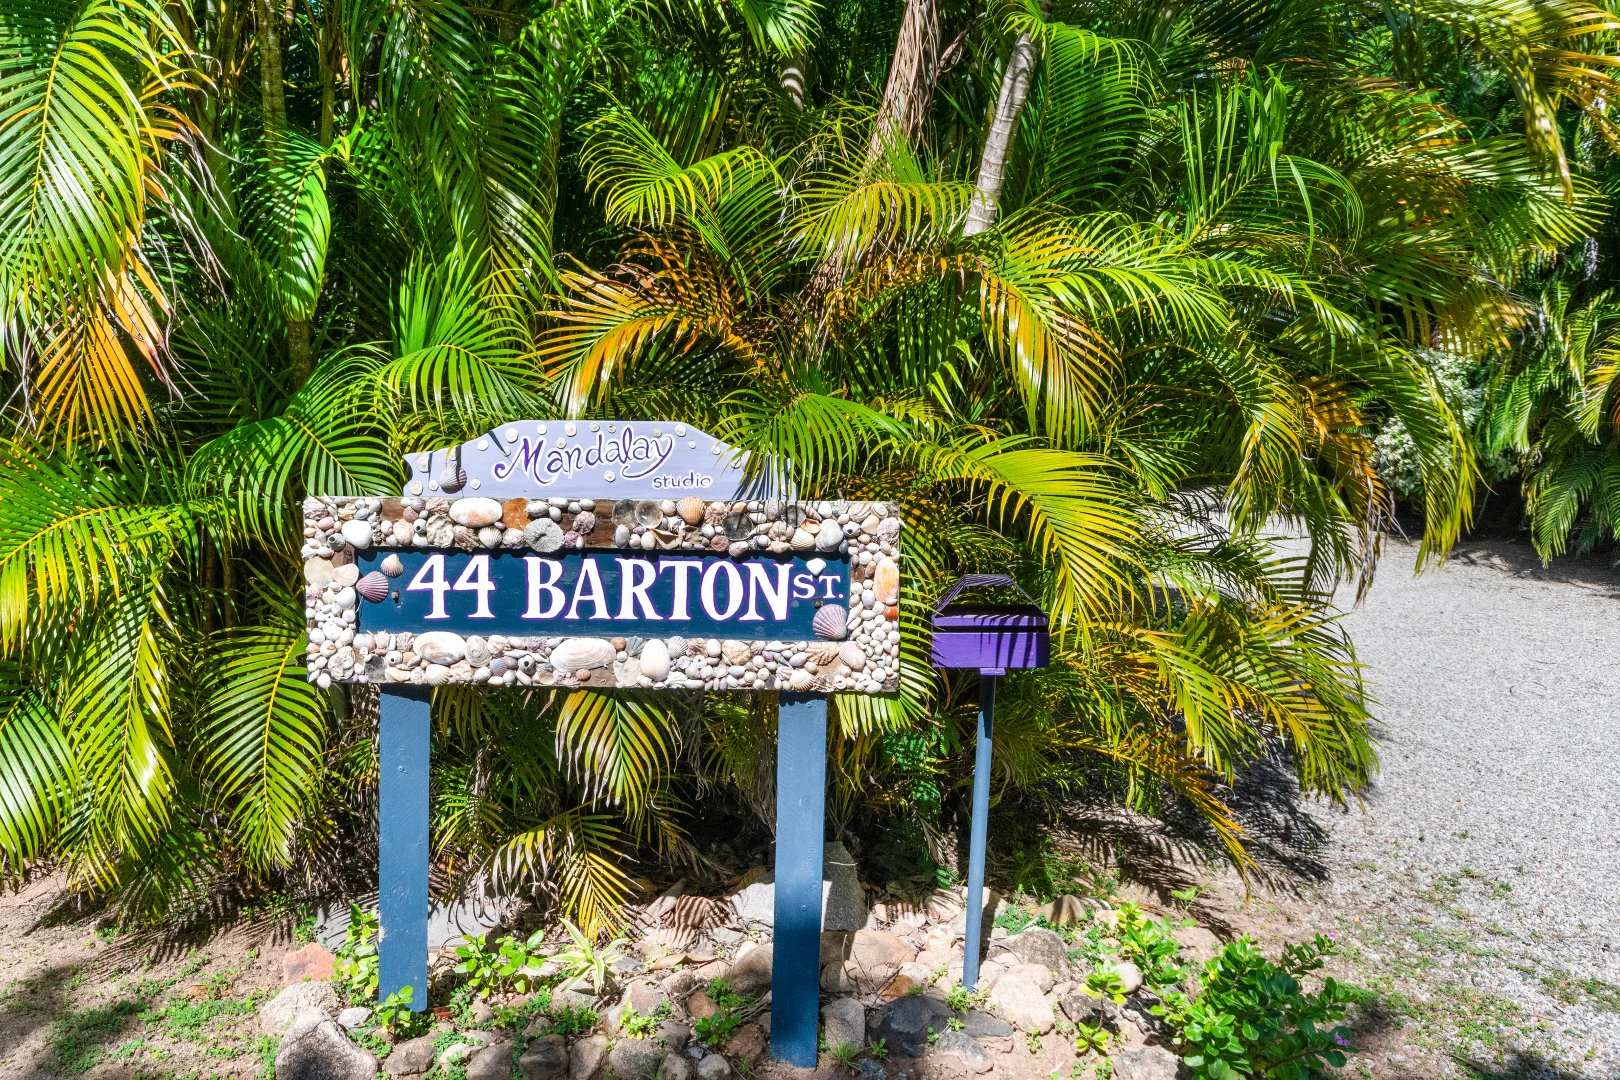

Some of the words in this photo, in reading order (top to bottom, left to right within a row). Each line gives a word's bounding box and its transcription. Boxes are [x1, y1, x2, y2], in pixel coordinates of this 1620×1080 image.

[493, 425, 674, 484] Mandalay
[653, 473, 711, 488] studio
[407, 554, 496, 619] 44
[522, 556, 793, 620] BARTON
[792, 574, 844, 599] ST.
